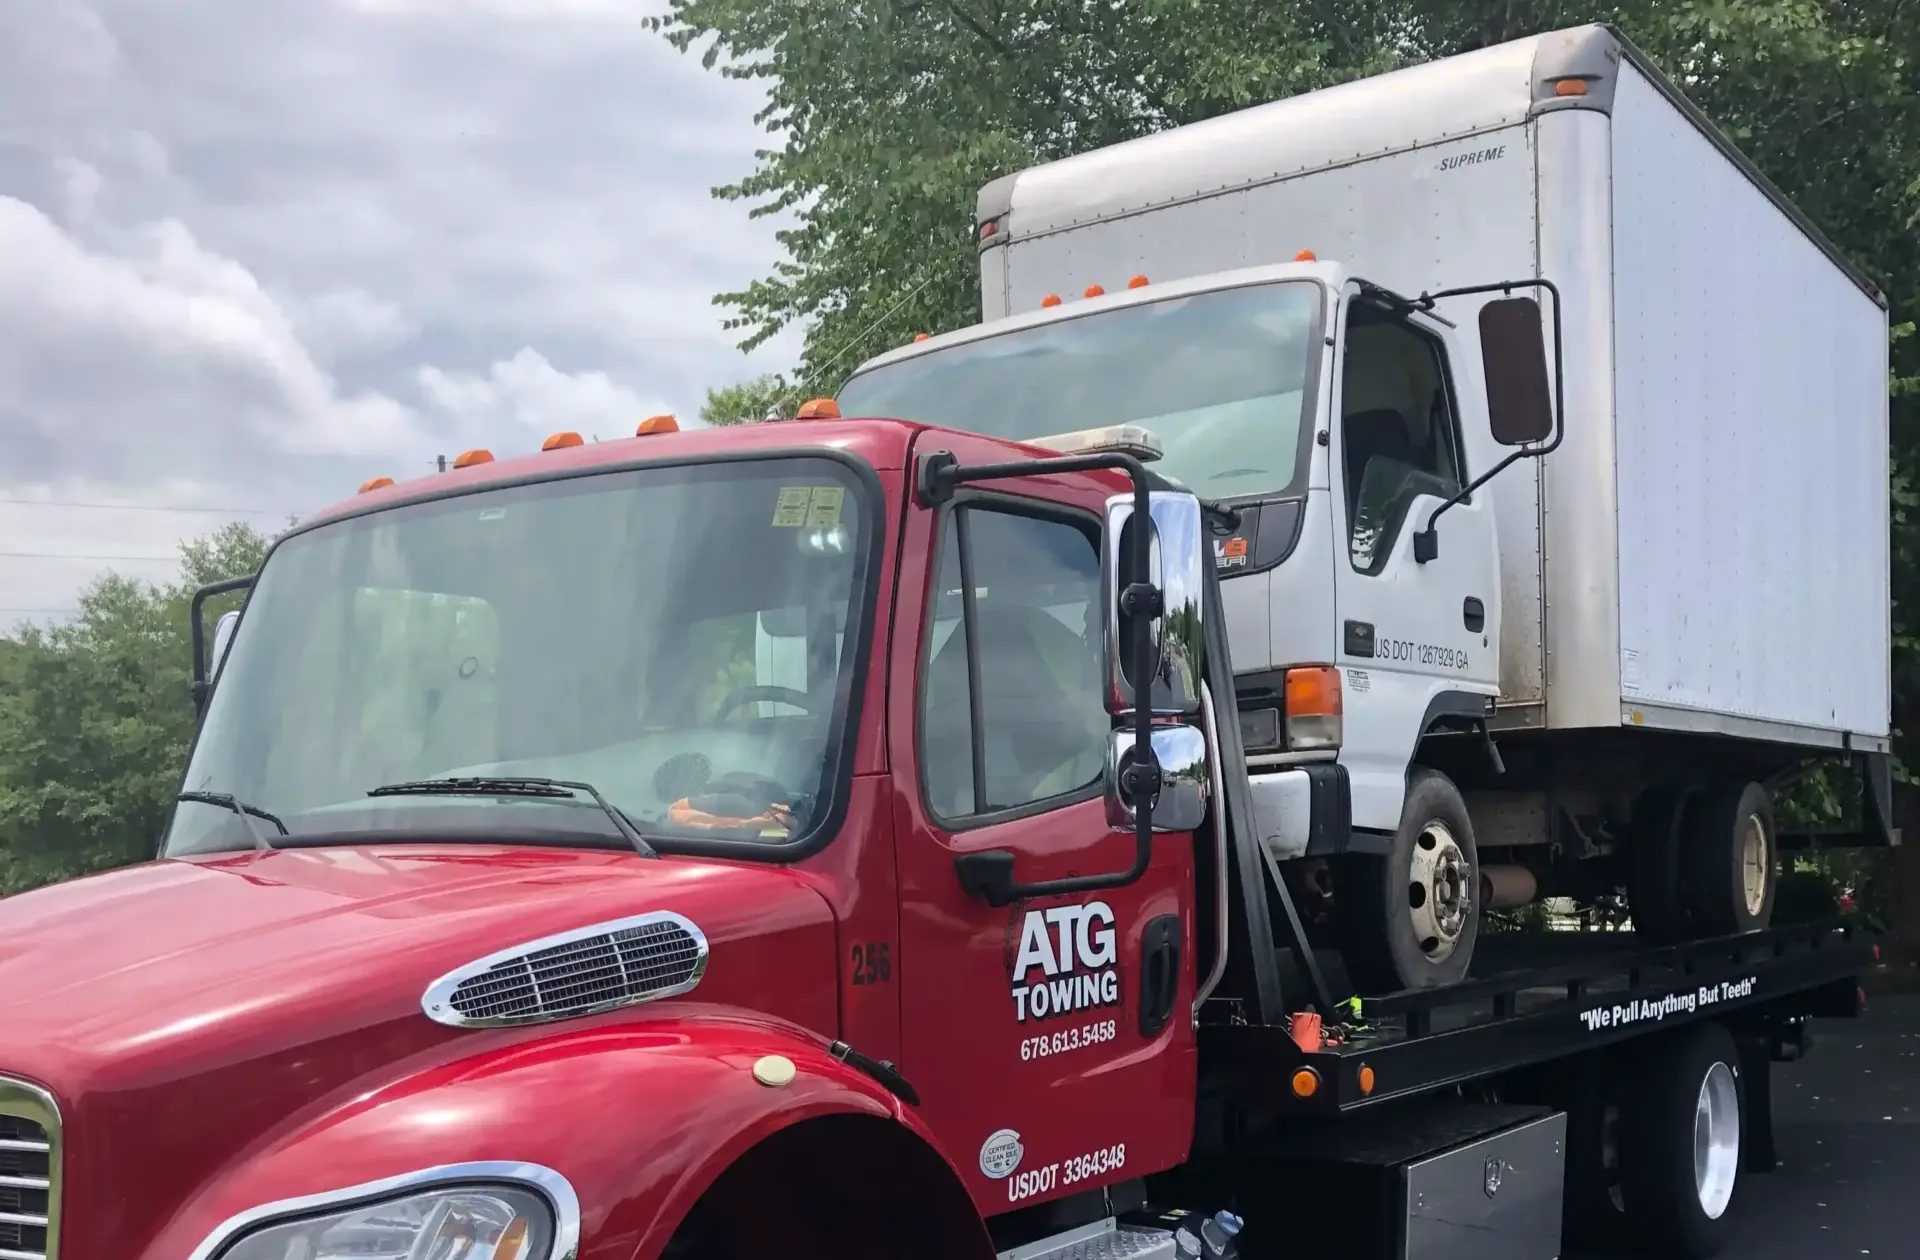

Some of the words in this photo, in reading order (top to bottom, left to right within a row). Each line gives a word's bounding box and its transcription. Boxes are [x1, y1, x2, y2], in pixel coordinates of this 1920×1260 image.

[1440, 145, 1506, 171] SUPREME
[1375, 638, 1390, 659] US
[1392, 640, 1415, 662] DOT
[1417, 643, 1454, 668] 1267929
[1456, 650, 1469, 670] GA
[1012, 901, 1117, 982] ATG
[852, 942, 892, 986] 256
[1012, 970, 1118, 1021] TOWING
[1580, 1006, 1611, 1031] "We
[1612, 1000, 1639, 1027] Pull
[1640, 993, 1696, 1021] Anything
[1699, 984, 1719, 1006] But
[1721, 976, 1757, 1000] Teeth"
[1020, 1019, 1116, 1061] 678.613.5458
[985, 1154, 1003, 1163] CLEAN
[1008, 1163, 1060, 1202] USDOT
[1062, 1143, 1126, 1185] 3364348
